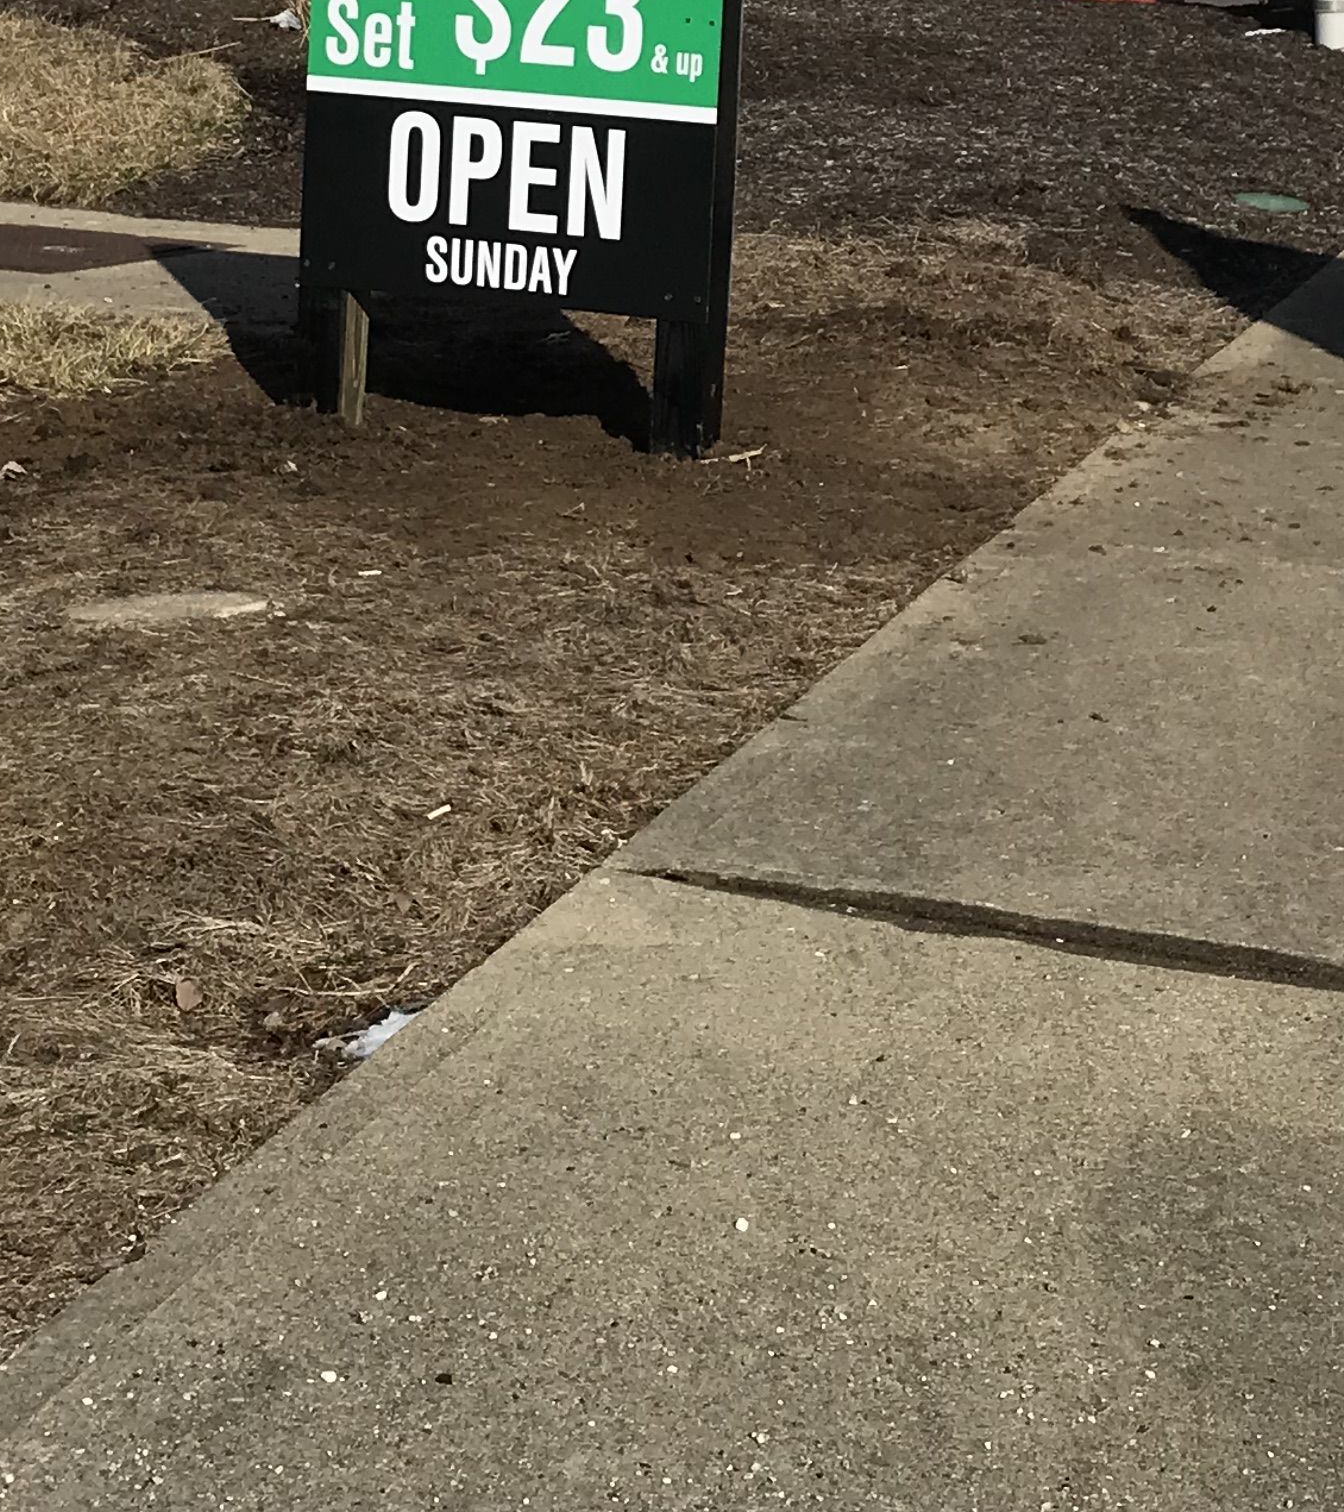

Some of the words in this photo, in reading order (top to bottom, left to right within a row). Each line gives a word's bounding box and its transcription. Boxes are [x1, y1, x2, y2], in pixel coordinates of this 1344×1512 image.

[651, 43, 667, 75] &
[675, 52, 703, 82] up
[388, 110, 627, 241] OPEN
[425, 234, 578, 296] SUNDAY
